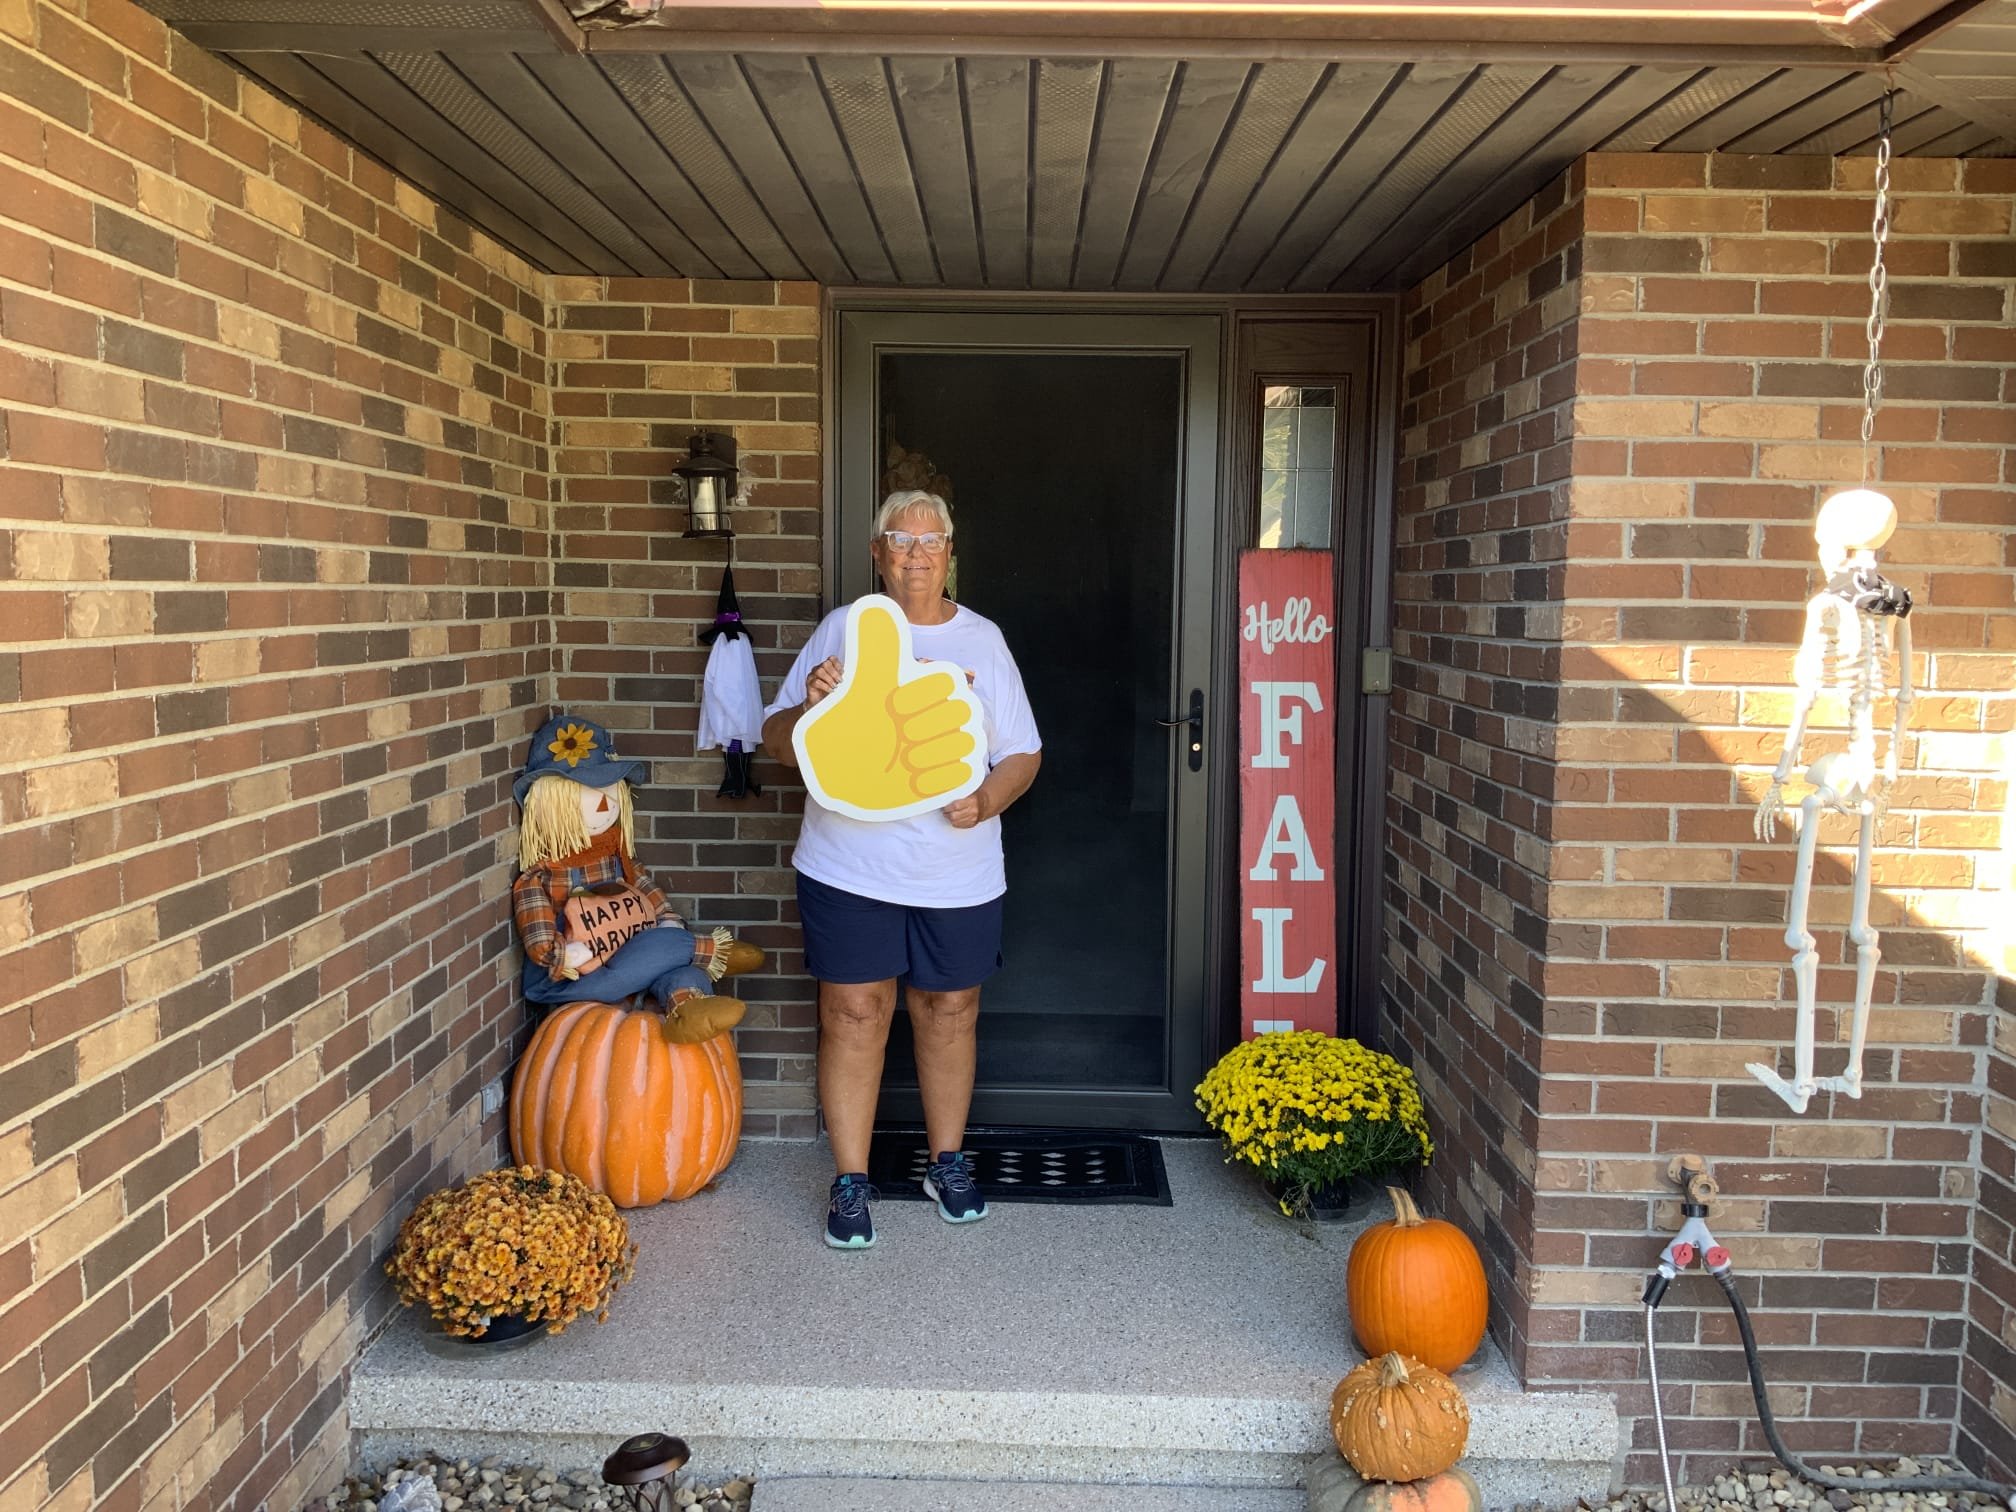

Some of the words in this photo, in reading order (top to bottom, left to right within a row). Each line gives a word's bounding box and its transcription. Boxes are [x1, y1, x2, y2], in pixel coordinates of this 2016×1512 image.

[1243, 596, 1333, 655] Hello
[1249, 681, 1327, 1036] FAL
[579, 895, 645, 931] HAPPY
